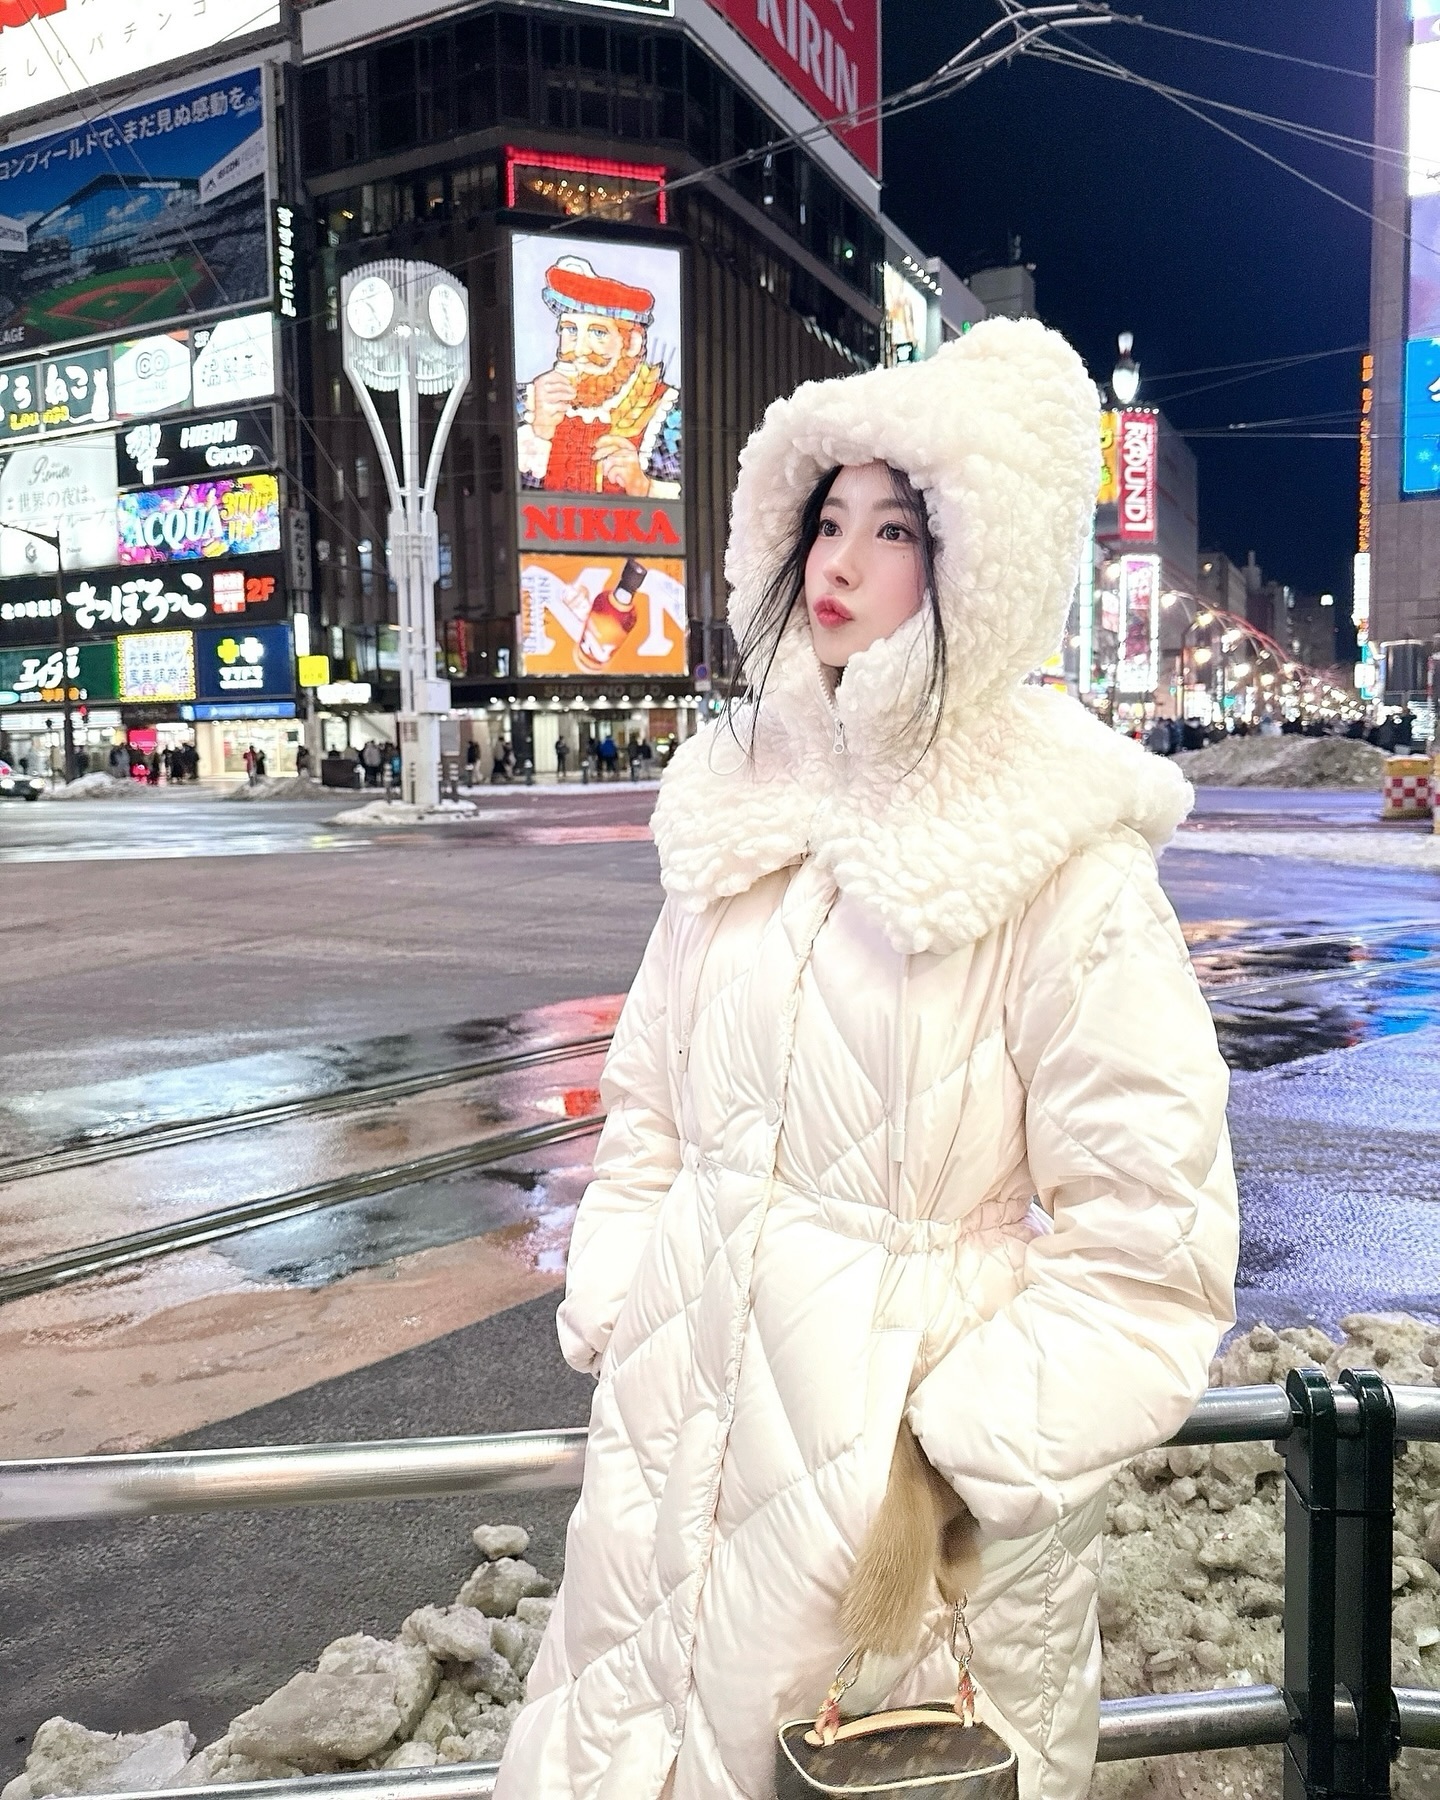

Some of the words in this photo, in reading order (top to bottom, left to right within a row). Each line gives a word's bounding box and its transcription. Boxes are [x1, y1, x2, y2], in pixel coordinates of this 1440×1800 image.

[180, 420, 238, 448] HIBIKI
[1123, 421, 1153, 532] ROUND1
[122, 504, 223, 550] ACQUA
[522, 504, 682, 544] NIKKA
[66, 572, 207, 629] さっぽろっこ
[246, 577, 275, 603] 2F
[538, 576, 550, 627] NIKKA
